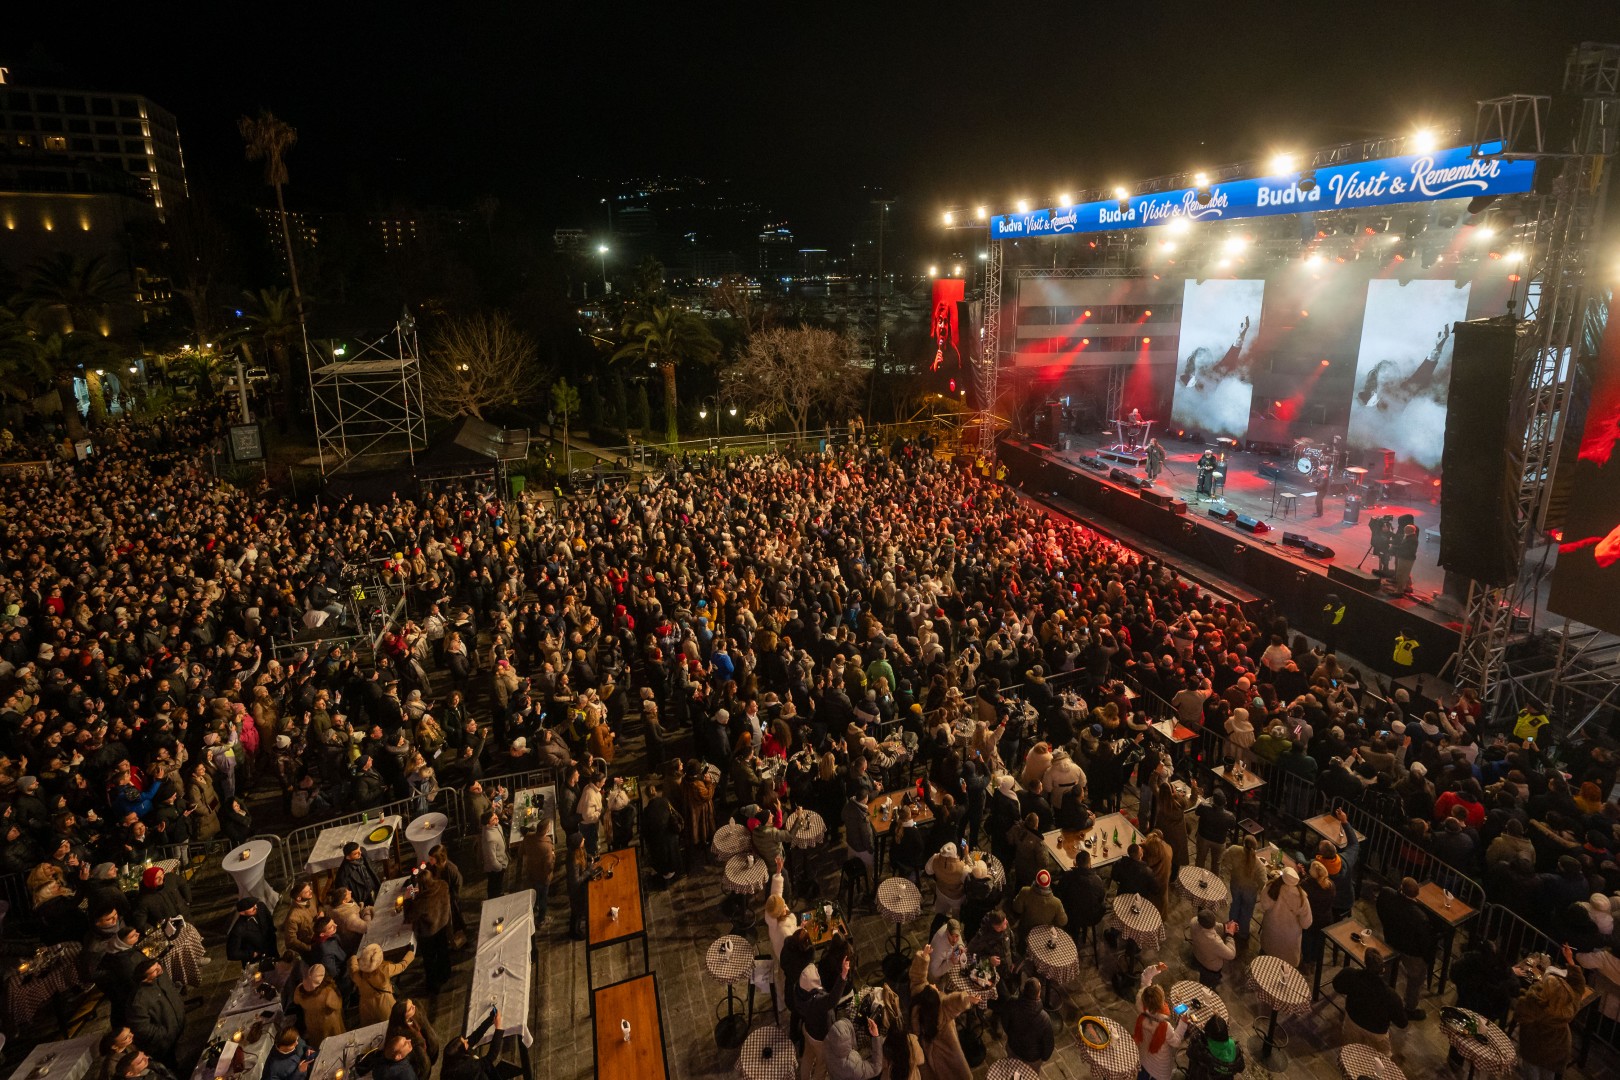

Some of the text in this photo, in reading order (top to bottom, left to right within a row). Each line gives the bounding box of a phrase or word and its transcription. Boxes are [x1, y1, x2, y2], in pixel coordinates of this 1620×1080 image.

[1257, 150, 1501, 207] Budva Visit & Remember
[1099, 206, 1135, 224] Budva
[1139, 199, 1172, 224] Visit
[1172, 204, 1181, 217] &
[999, 219, 1022, 233] Budva
[1024, 215, 1044, 234] Visit
